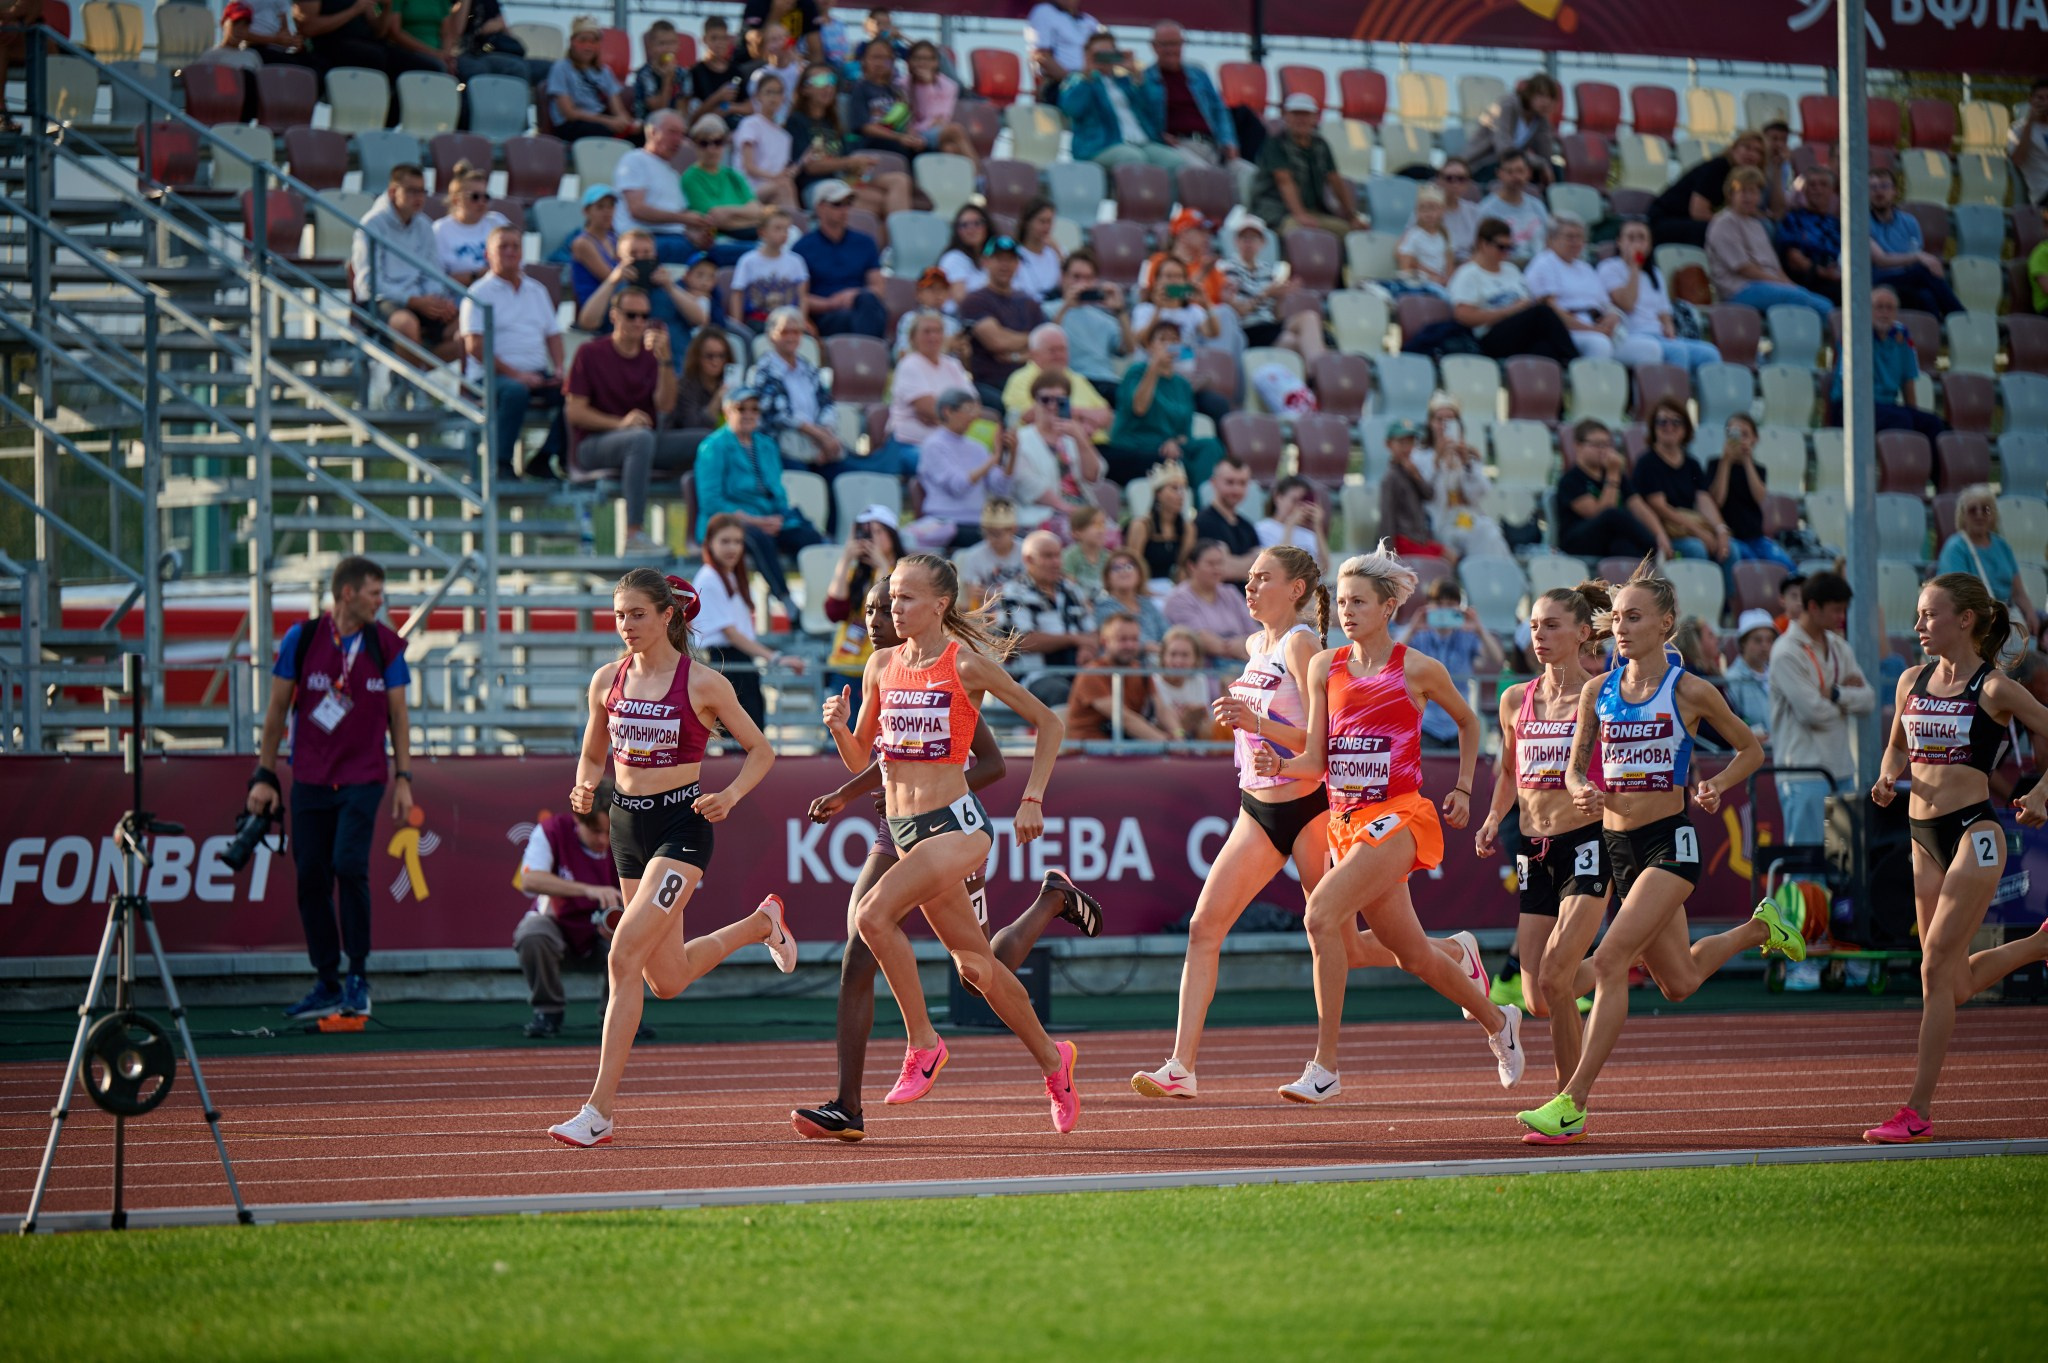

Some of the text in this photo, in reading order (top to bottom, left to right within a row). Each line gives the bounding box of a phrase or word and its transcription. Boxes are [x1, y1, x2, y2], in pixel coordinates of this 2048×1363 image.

[613, 700, 676, 718] FONBET
[885, 690, 945, 706] FONBET
[1909, 697, 1968, 714] FONBET
[1603, 722, 1665, 738] FONBET
[1908, 721, 1958, 740] РЕШТАН
[1328, 736, 1384, 751] FONBET
[1524, 745, 1571, 762] ИЛЬИНА
[621, 798, 655, 810] PRO
[663, 783, 700, 807] NIKE
[962, 802, 977, 826] 6
[785, 815, 1155, 885] КОЛЕВА
[1681, 832, 1691, 857] 1
[1979, 837, 1994, 861] 2
[0, 834, 289, 905] FONBET
[1578, 848, 1593, 870] 3
[658, 873, 683, 909] 8
[972, 895, 983, 920] 7
